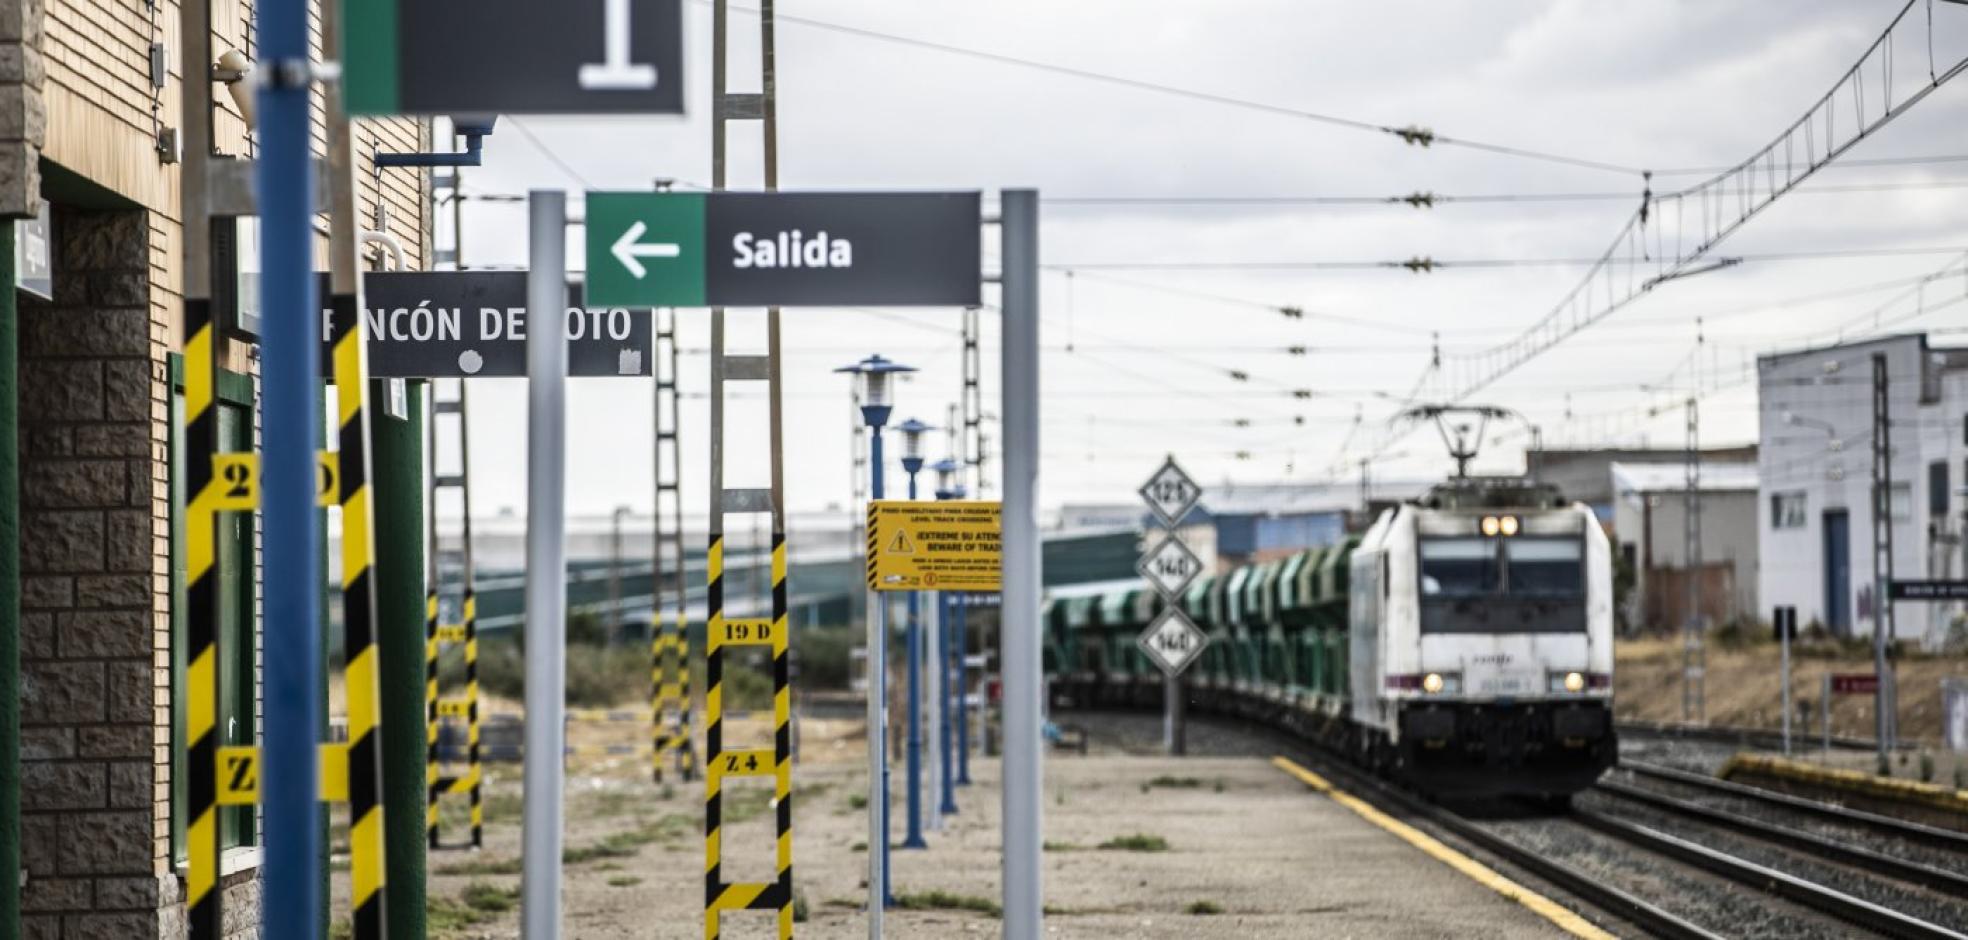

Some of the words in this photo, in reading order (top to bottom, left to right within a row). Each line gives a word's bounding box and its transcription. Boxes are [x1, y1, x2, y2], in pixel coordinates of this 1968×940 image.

[732, 229, 852, 268] Salida
[322, 300, 461, 341] RNCÓN
[479, 307, 527, 341] DE
[563, 307, 632, 341] OTO
[726, 624, 749, 640] 19
[758, 623, 770, 640] D
